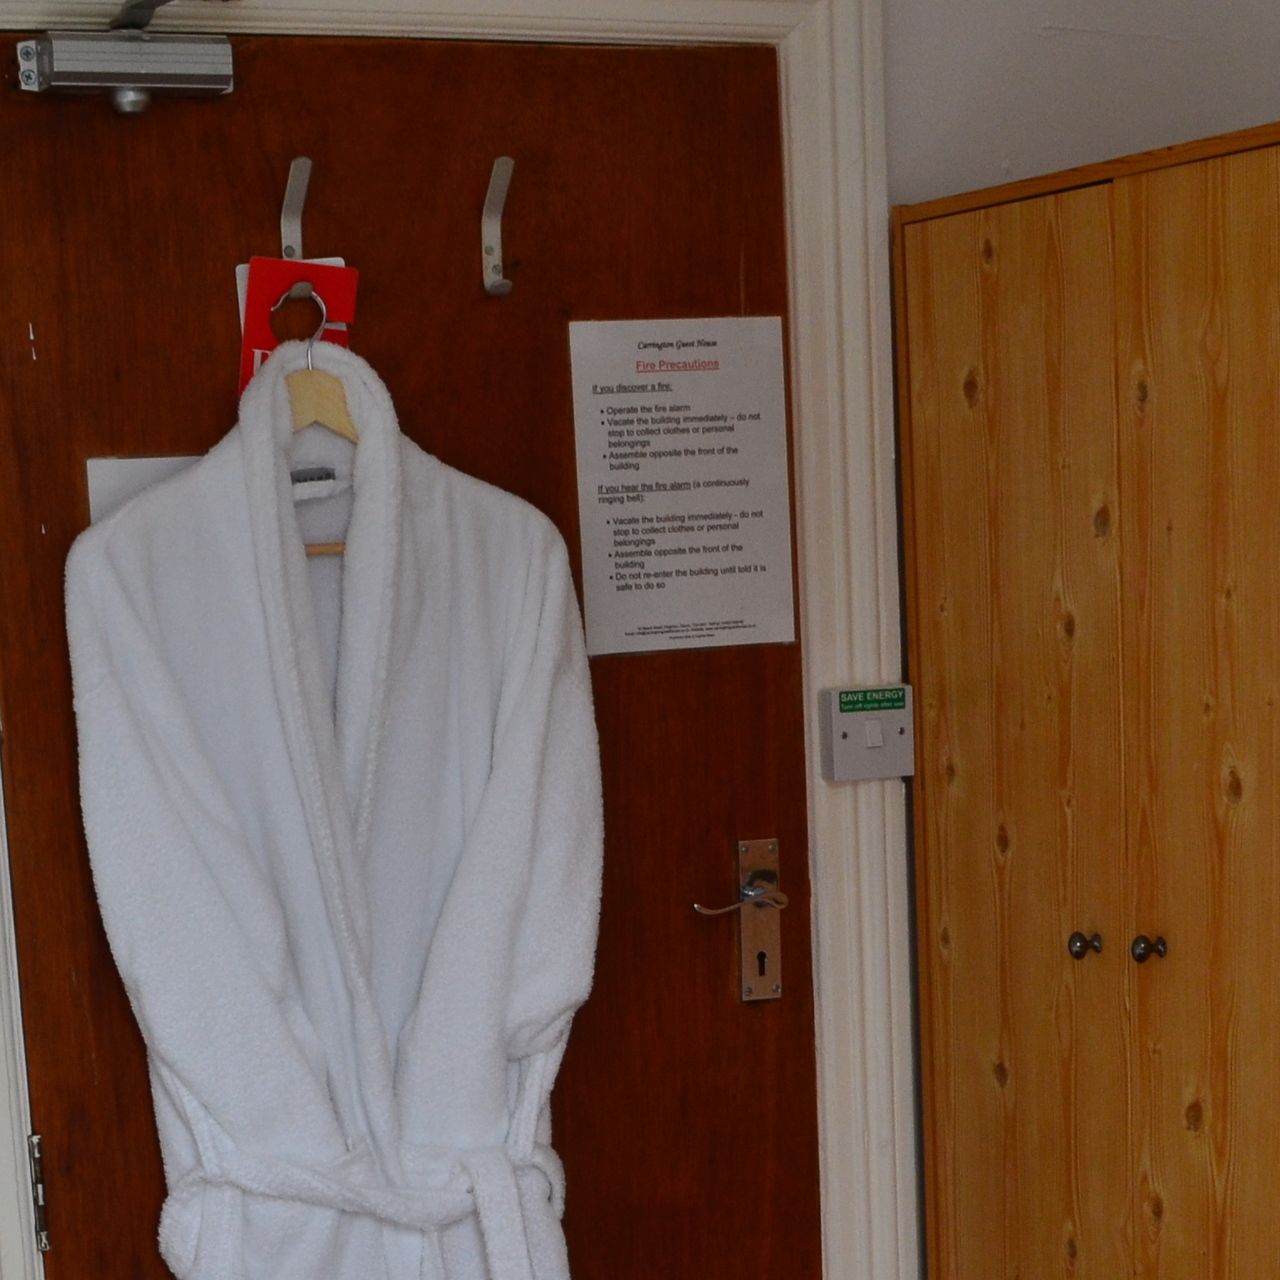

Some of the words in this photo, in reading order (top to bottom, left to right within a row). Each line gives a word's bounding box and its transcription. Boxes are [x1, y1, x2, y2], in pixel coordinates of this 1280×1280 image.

[636, 361, 656, 370] Fire
[659, 358, 719, 370] Precautions
[599, 386, 614, 394] you
[615, 383, 648, 392] discover
[606, 405, 638, 416] Operate
[639, 405, 652, 413] the
[654, 404, 667, 413] fire
[668, 403, 690, 412] alarm
[607, 417, 634, 426] Vacate
[636, 416, 649, 425] the
[650, 415, 680, 426] building
[682, 413, 728, 425] immediately
[748, 412, 761, 421] not
[608, 428, 625, 438] stop
[635, 427, 661, 436] collect
[662, 426, 690, 435] clothes
[701, 424, 734, 435] personal
[608, 438, 650, 449] belongings
[609, 450, 647, 460] Assemble
[648, 448, 682, 460] opposite
[683, 448, 696, 456] the
[697, 447, 715, 456] front
[726, 446, 738, 455] the
[610, 461, 640, 472] building
[604, 486, 619, 494] you
[620, 483, 639, 492] hear
[640, 482, 653, 491] the
[654, 482, 667, 490] fire
[668, 481, 691, 490] alarm
[702, 478, 750, 490] continuously
[598, 494, 624, 505] ringing
[612, 516, 639, 525] Vacate
[641, 515, 654, 524] the
[655, 514, 685, 525] building
[686, 511, 732, 523] immediately
[750, 510, 763, 518] not
[613, 527, 630, 538] stop
[641, 525, 666, 535] collect
[667, 524, 695, 533] clothes
[706, 521, 739, 533] personal
[614, 537, 655, 548] belongings
[615, 548, 652, 558] Assemble
[653, 546, 686, 558] opposite
[688, 545, 700, 554] the
[702, 544, 720, 553] front
[730, 543, 743, 551] the
[615, 560, 644, 570] building
[628, 571, 641, 580] not
[642, 569, 673, 579] re-enter
[674, 568, 687, 577] the
[688, 567, 718, 578] building
[720, 566, 736, 575] until
[737, 565, 751, 574] told
[616, 582, 633, 591] safe
[841, 692, 864, 702] SAVE
[867, 690, 903, 700] ENERGY
